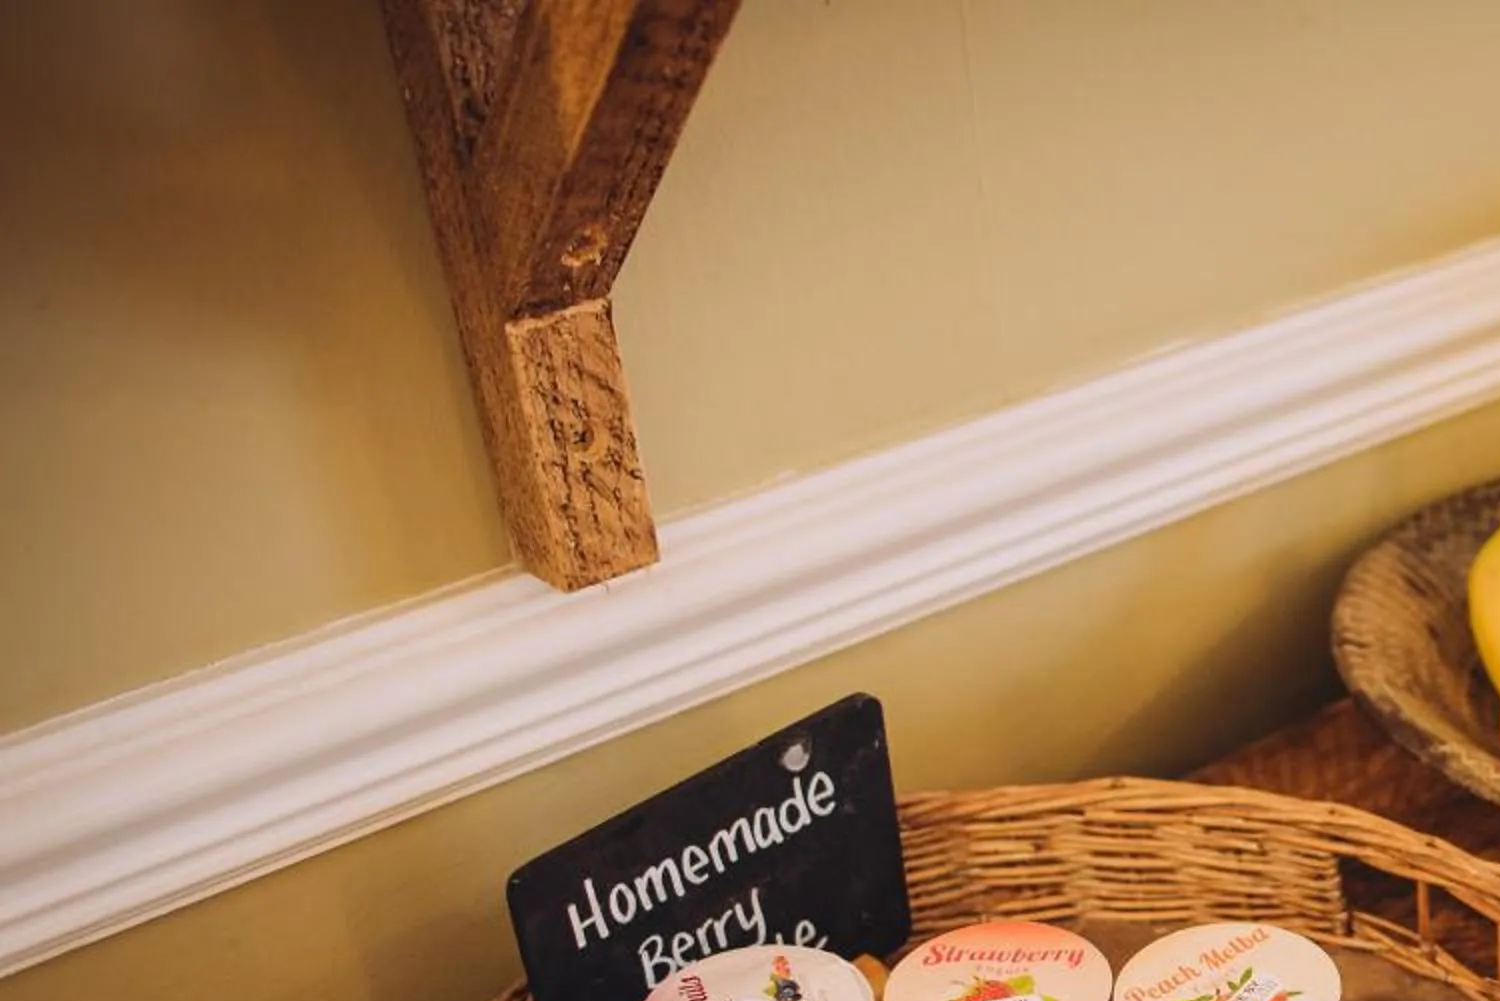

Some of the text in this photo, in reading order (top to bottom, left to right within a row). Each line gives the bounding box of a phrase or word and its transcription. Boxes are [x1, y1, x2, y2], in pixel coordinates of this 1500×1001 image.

[567, 770, 836, 949] Homemade
[638, 886, 768, 989] Berry
[922, 943, 1086, 968] Strawberry
[1199, 927, 1270, 972] Melba
